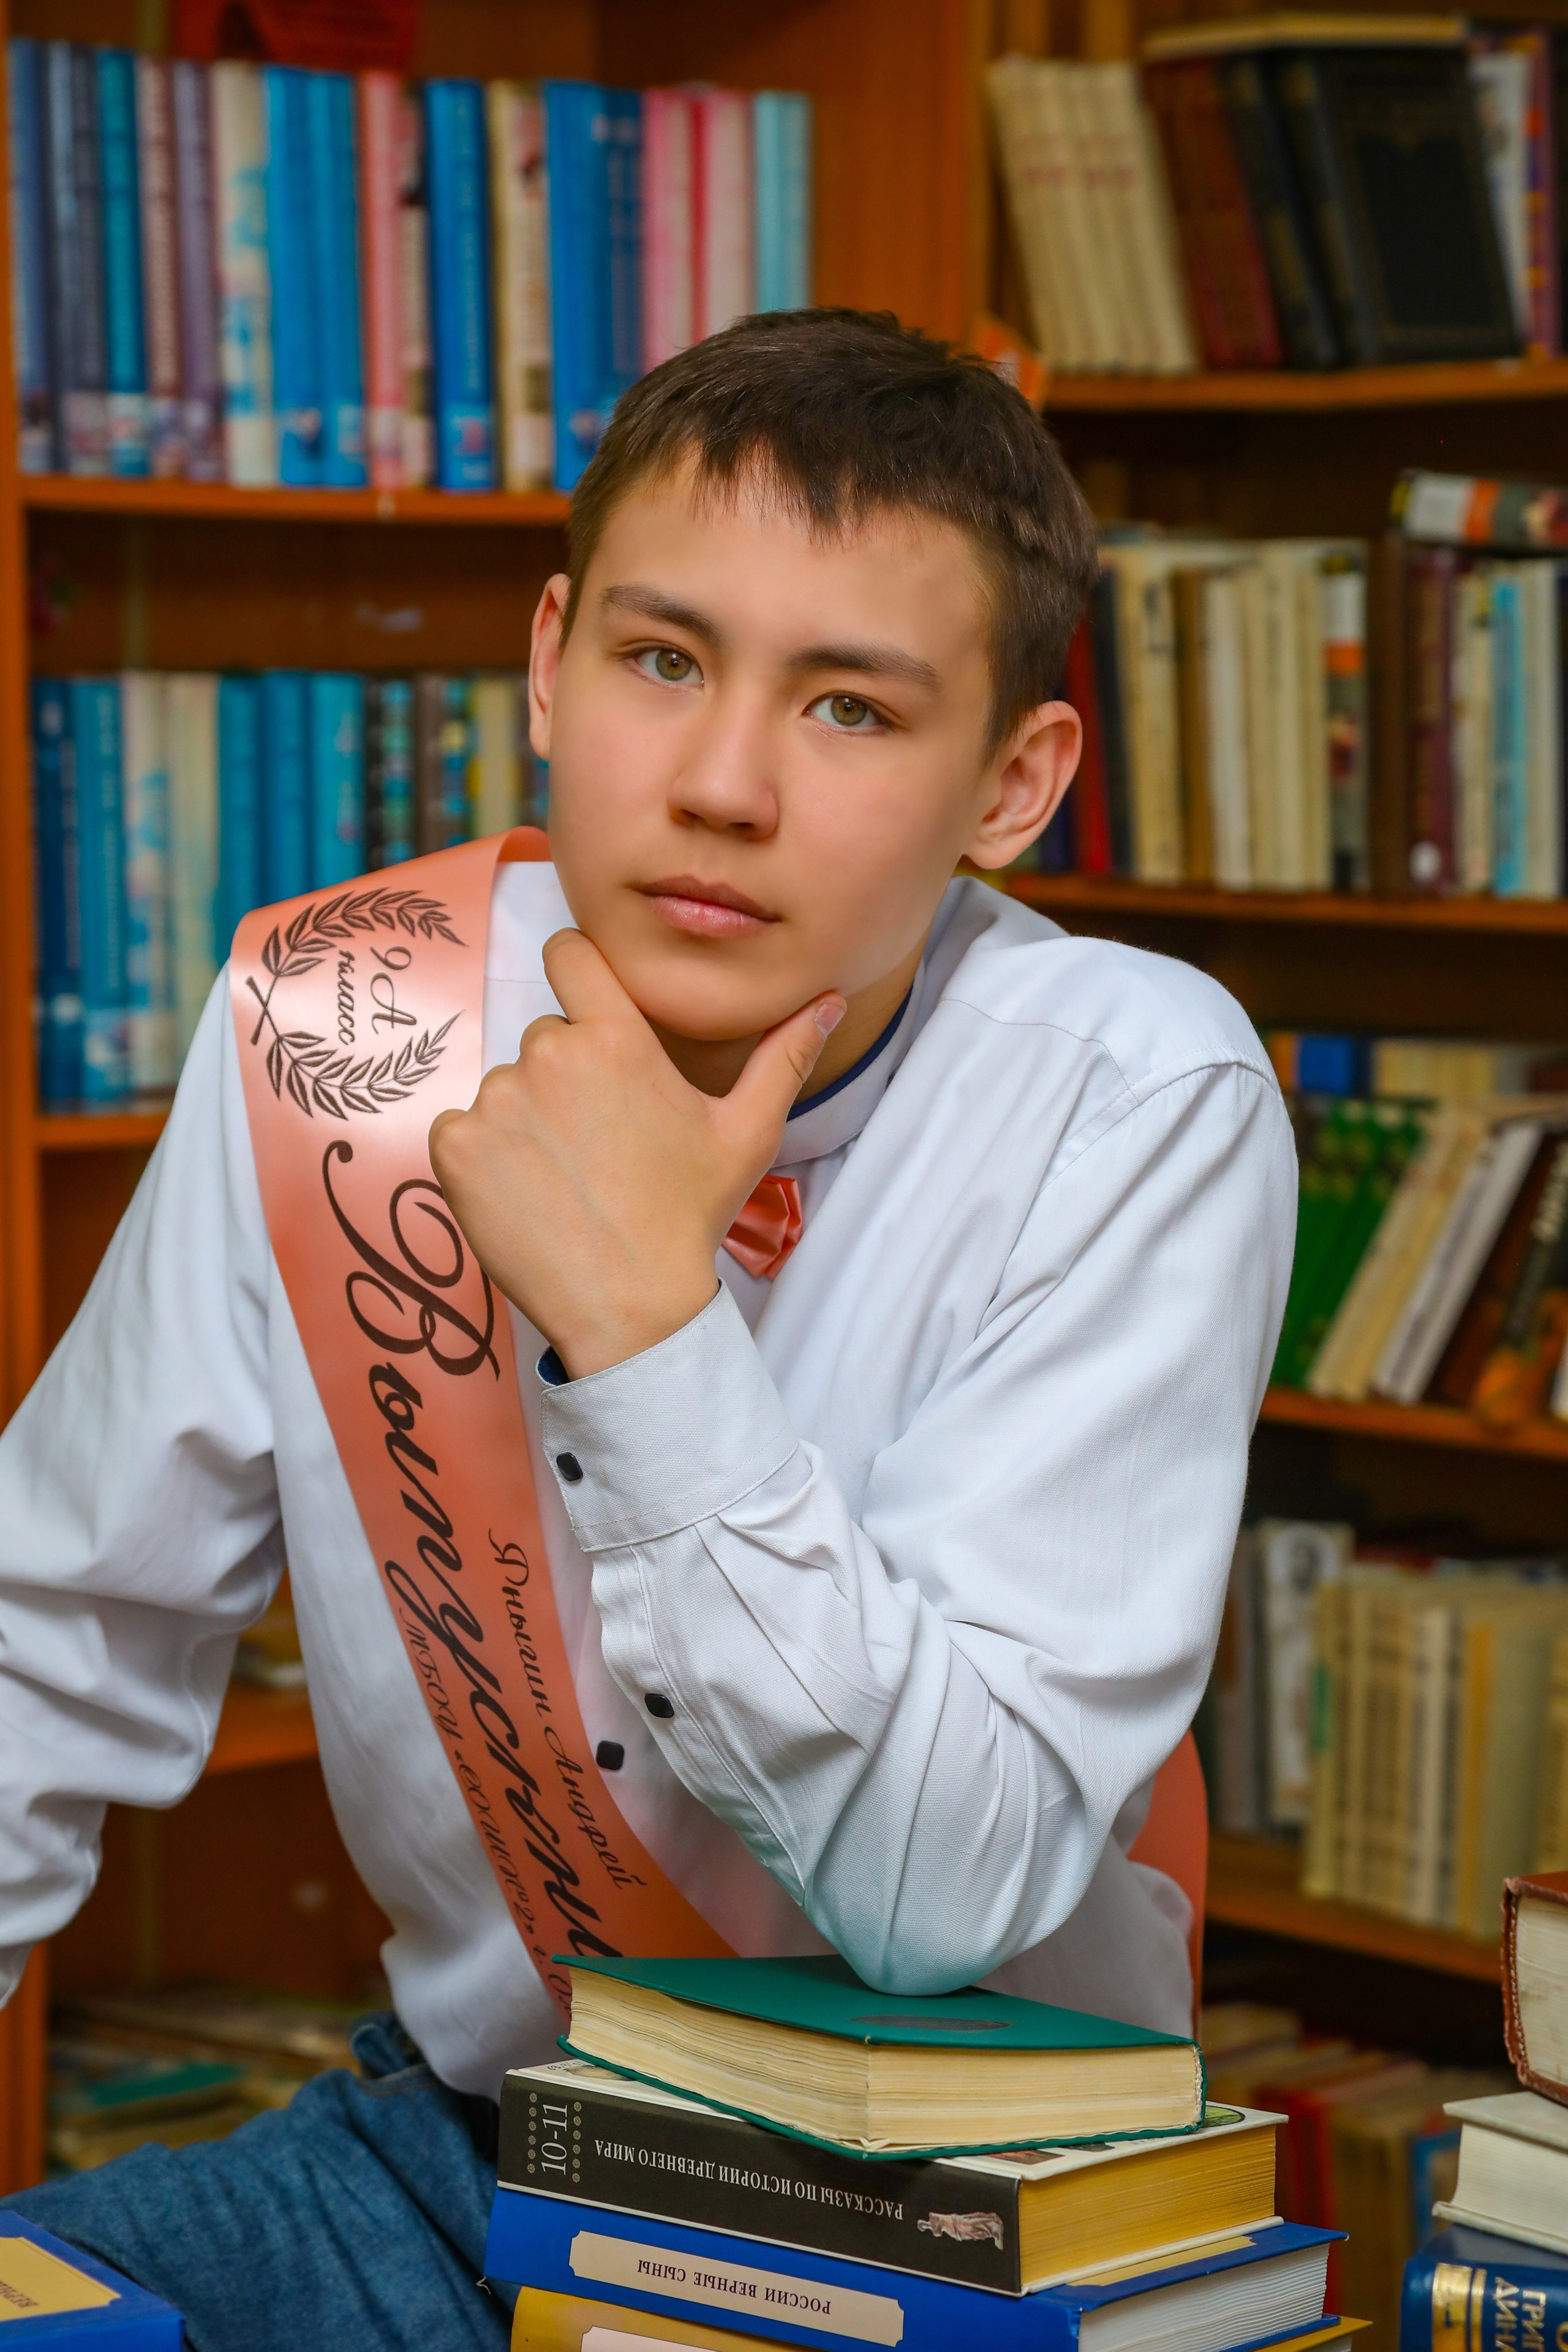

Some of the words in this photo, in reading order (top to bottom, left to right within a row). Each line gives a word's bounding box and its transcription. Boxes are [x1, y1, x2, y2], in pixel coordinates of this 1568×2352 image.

[336, 949, 357, 1046] класс
[399, 1607, 462, 1740] МБОУ
[488, 1527, 552, 1718] Яныгин
[544, 1725, 648, 1890] Андрей
[541, 2104, 568, 2175] 10-11
[594, 2139, 635, 2163] МИРА
[638, 2149, 715, 2180] ДРЕВНЕГО
[718, 2165, 791, 2196] ИСТОРИИ
[794, 2181, 817, 2201] ПО
[820, 2187, 903, 2220] РАССКАЗЫ
[637, 2259, 687, 2282] СЫНЫ
[693, 2272, 758, 2298] ВЕРНЫЕ
[764, 2287, 832, 2315] РОССИИ
